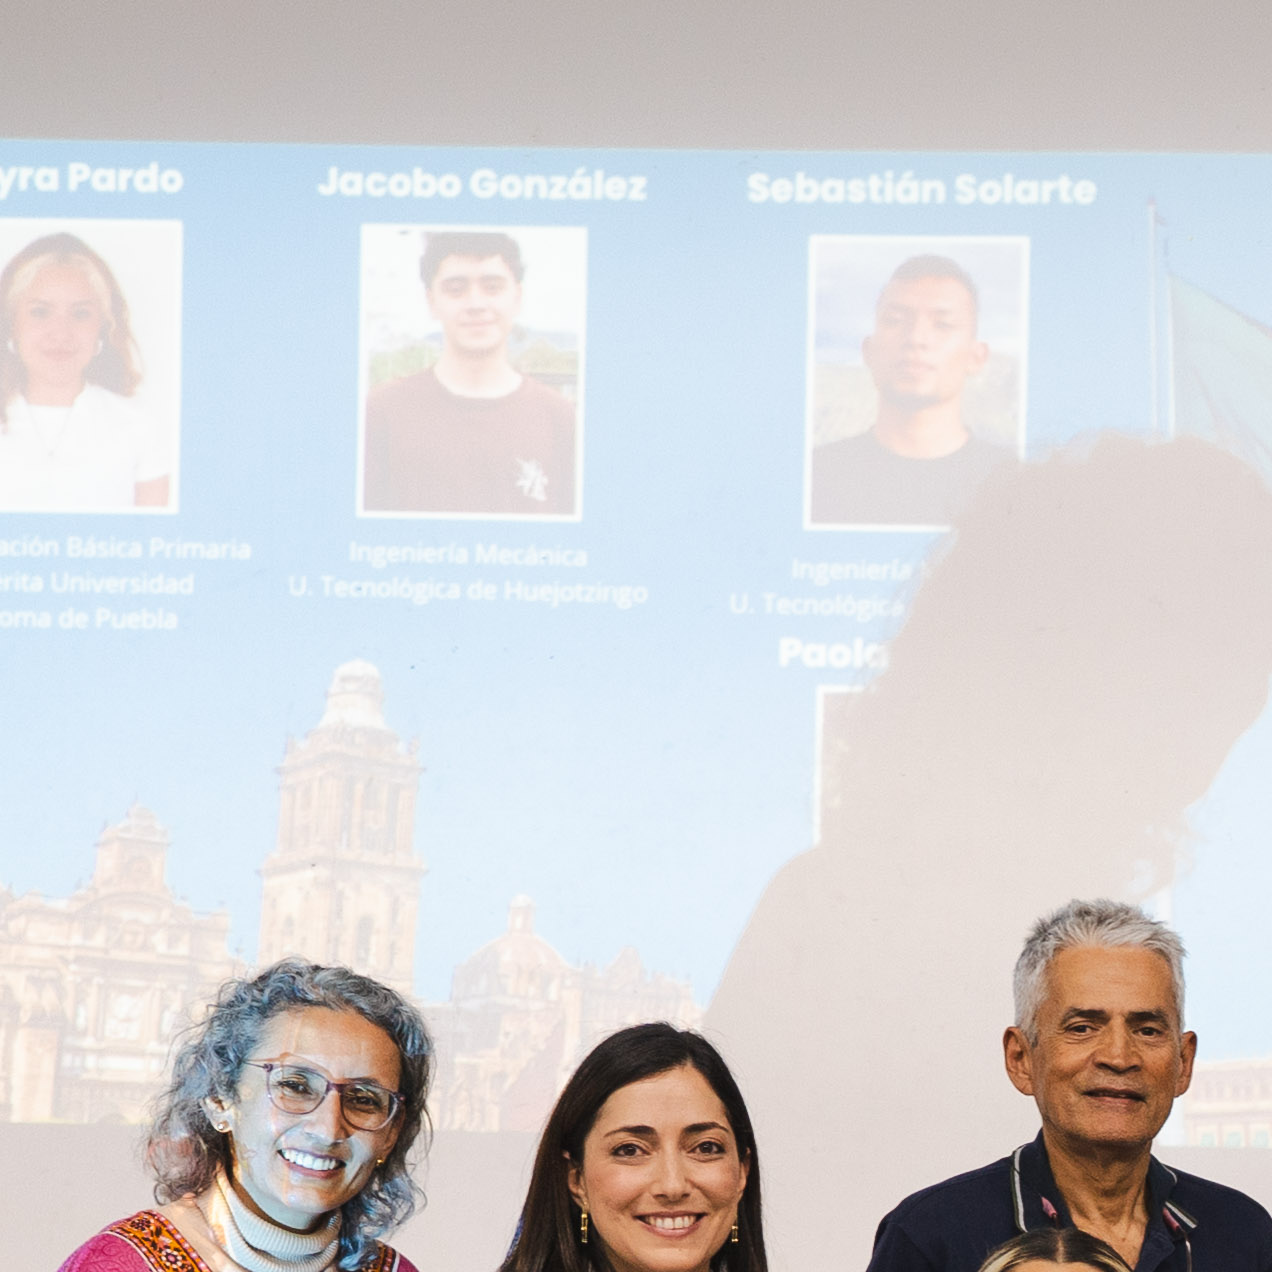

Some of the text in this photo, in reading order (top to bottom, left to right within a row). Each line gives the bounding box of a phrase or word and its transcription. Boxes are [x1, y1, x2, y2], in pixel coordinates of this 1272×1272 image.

[67, 162, 184, 194] Pardo
[318, 166, 648, 201] Jacobo González
[747, 170, 1098, 206] Sebastián Solarte
[67, 536, 143, 559] Básica
[150, 537, 252, 560] Primaria
[350, 541, 588, 569] Ingeniería Mecánica
[50, 572, 196, 595] Universidad
[792, 558, 913, 587] Ingeniería
[288, 575, 650, 610] U. Tecnológica de Huejotzingo
[730, 593, 756, 615] U.
[58, 608, 89, 629] de
[96, 608, 179, 630] Puebla
